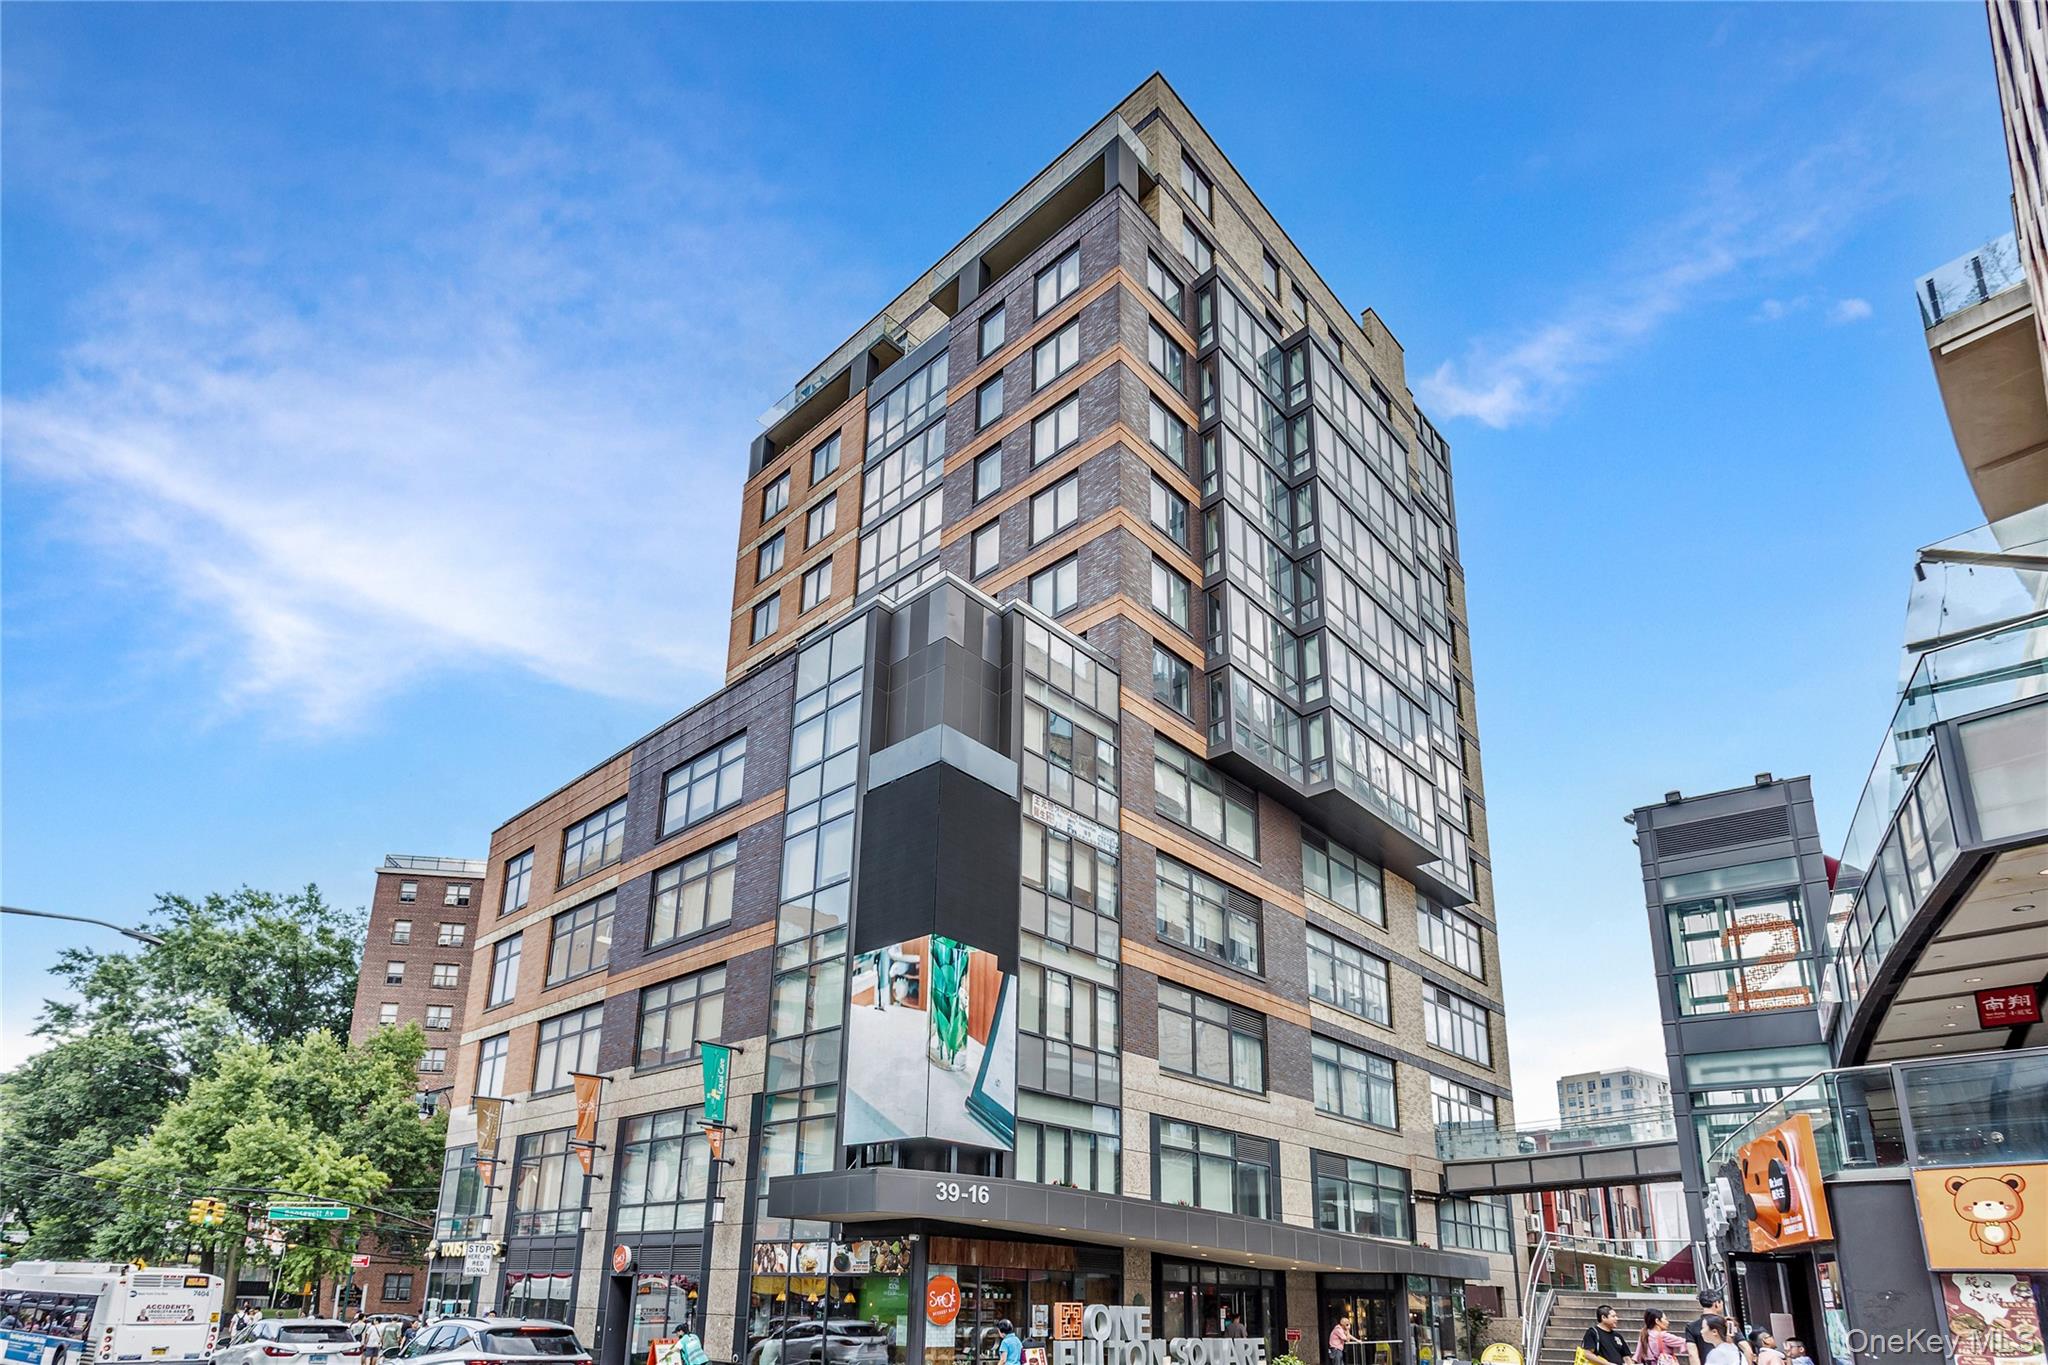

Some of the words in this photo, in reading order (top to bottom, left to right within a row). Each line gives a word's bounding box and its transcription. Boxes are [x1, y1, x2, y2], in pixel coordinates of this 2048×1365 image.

[1982, 994, 2031, 1011] 南翔
[936, 1182, 990, 1204] 39-16
[469, 1245, 491, 1253] STOP
[1083, 1304, 1152, 1341] ONE
